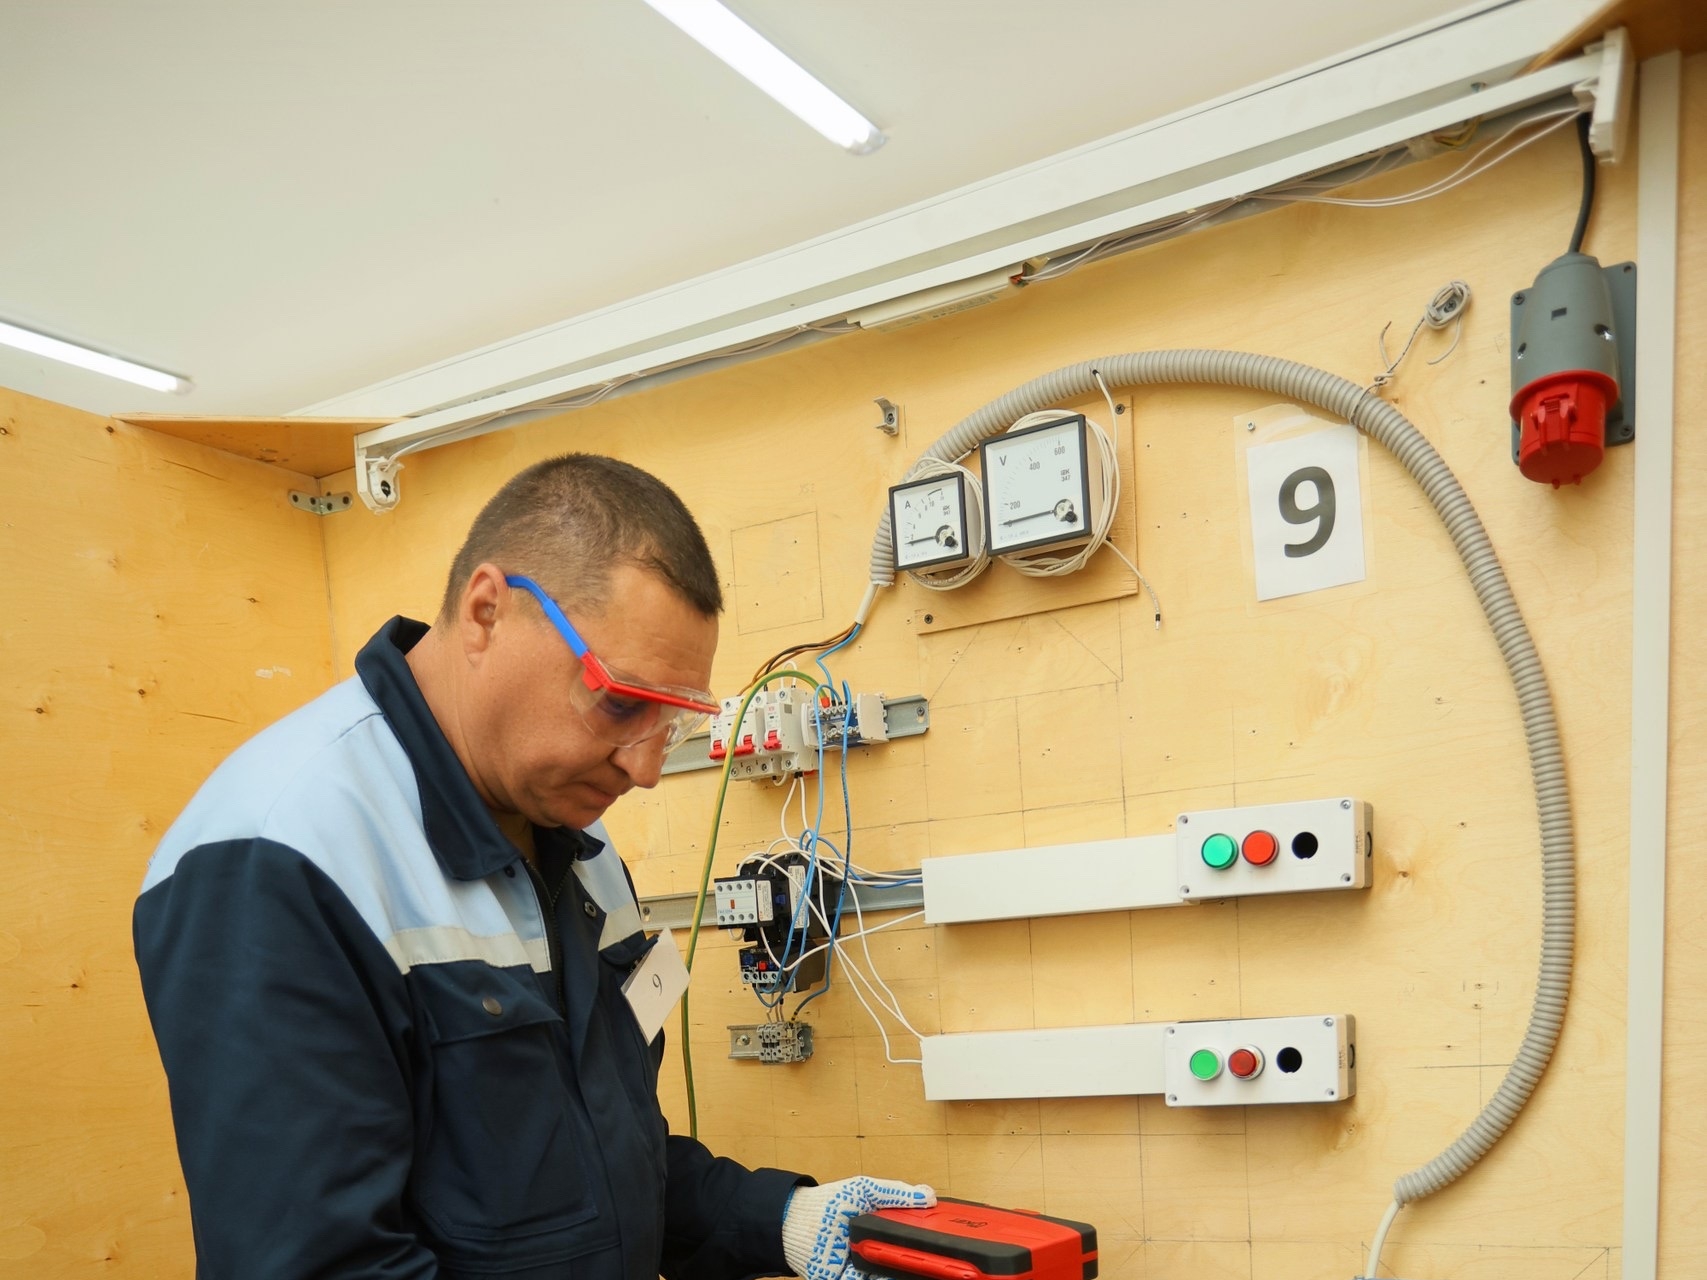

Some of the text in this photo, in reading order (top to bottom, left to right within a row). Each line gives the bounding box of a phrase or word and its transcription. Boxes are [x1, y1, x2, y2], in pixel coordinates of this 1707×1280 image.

[1054, 446, 1065, 456] 600
[999, 455, 1007, 466] V
[1029, 461, 1041, 471] 400
[904, 500, 911, 510] A
[1009, 500, 1021, 510] 200
[1278, 465, 1336, 558] 9
[653, 973, 663, 997] 9
